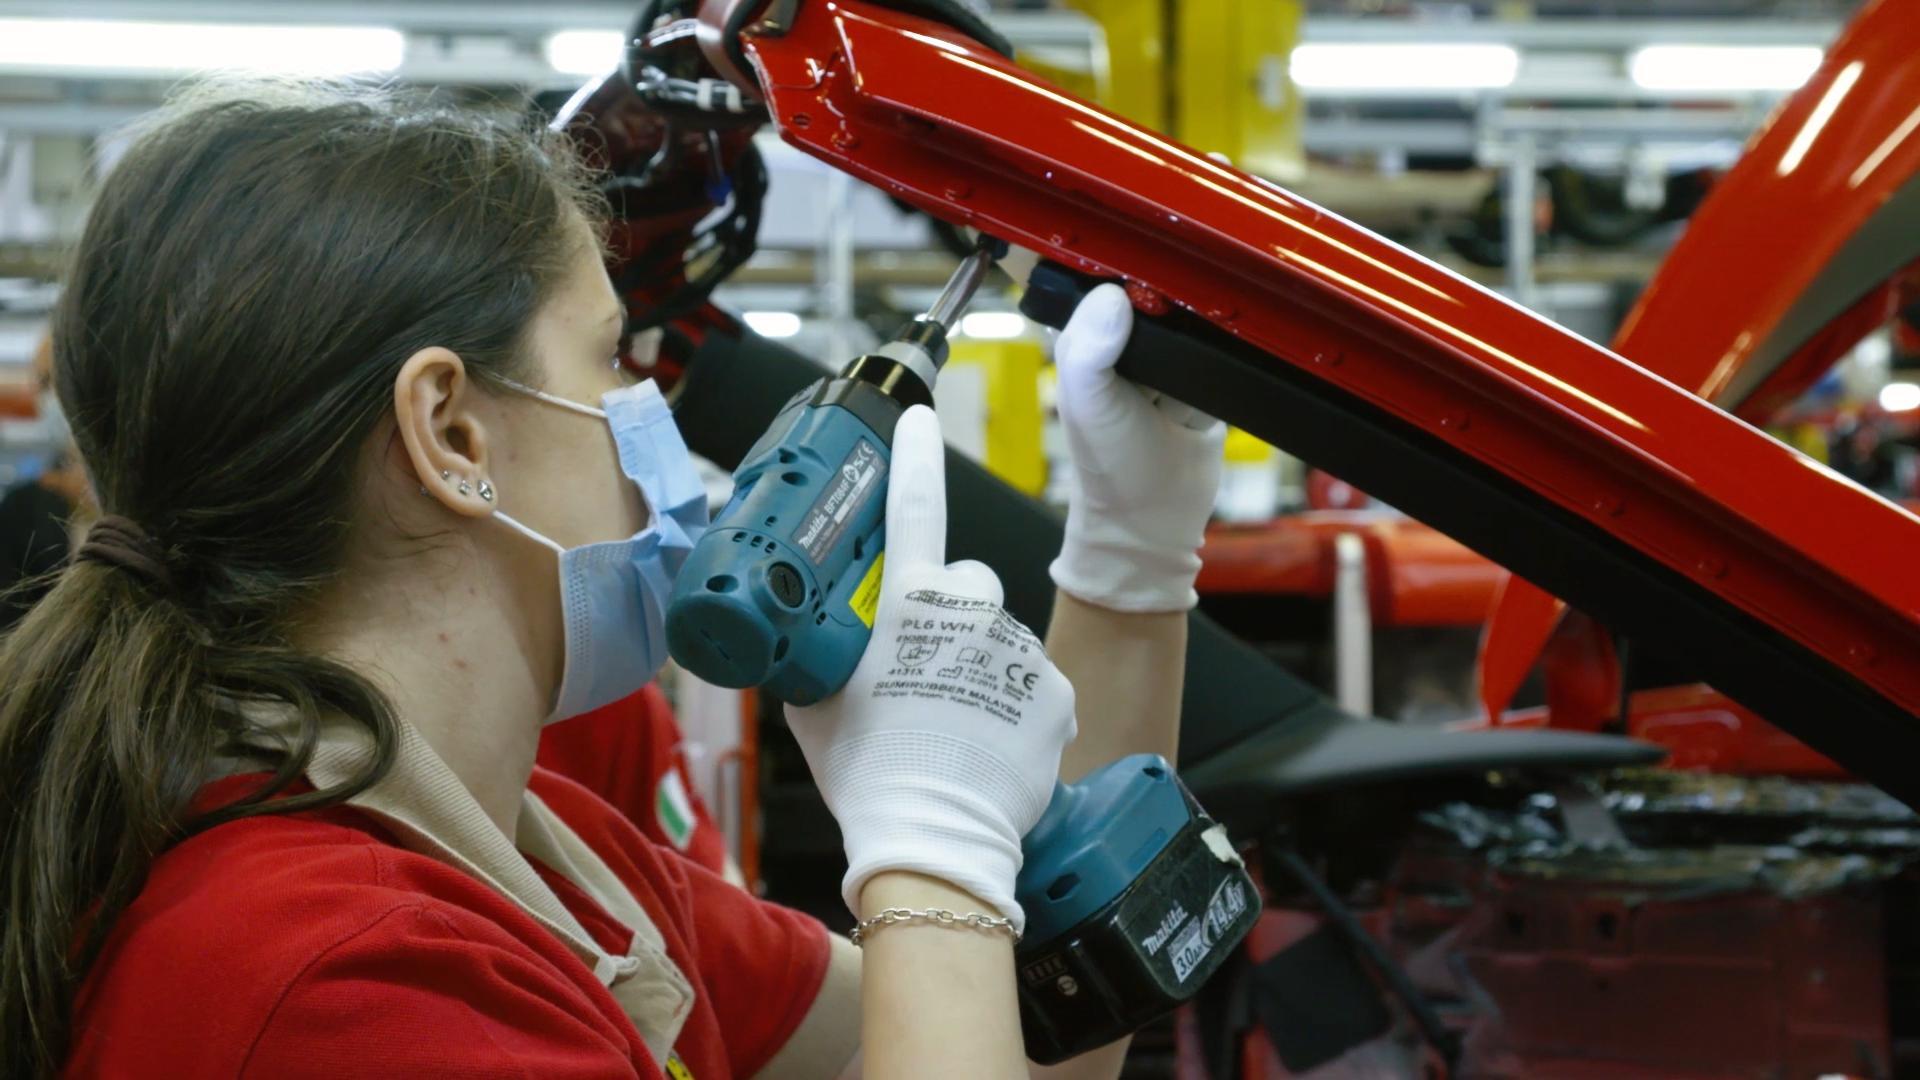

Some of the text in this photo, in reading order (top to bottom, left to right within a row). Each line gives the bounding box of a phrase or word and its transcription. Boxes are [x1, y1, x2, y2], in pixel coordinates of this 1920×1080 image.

[901, 619, 975, 633] PL6 WH
[986, 627, 1029, 654] Size 6
[969, 690, 1022, 717] MALAYSIA
[1142, 905, 1188, 955] makita
